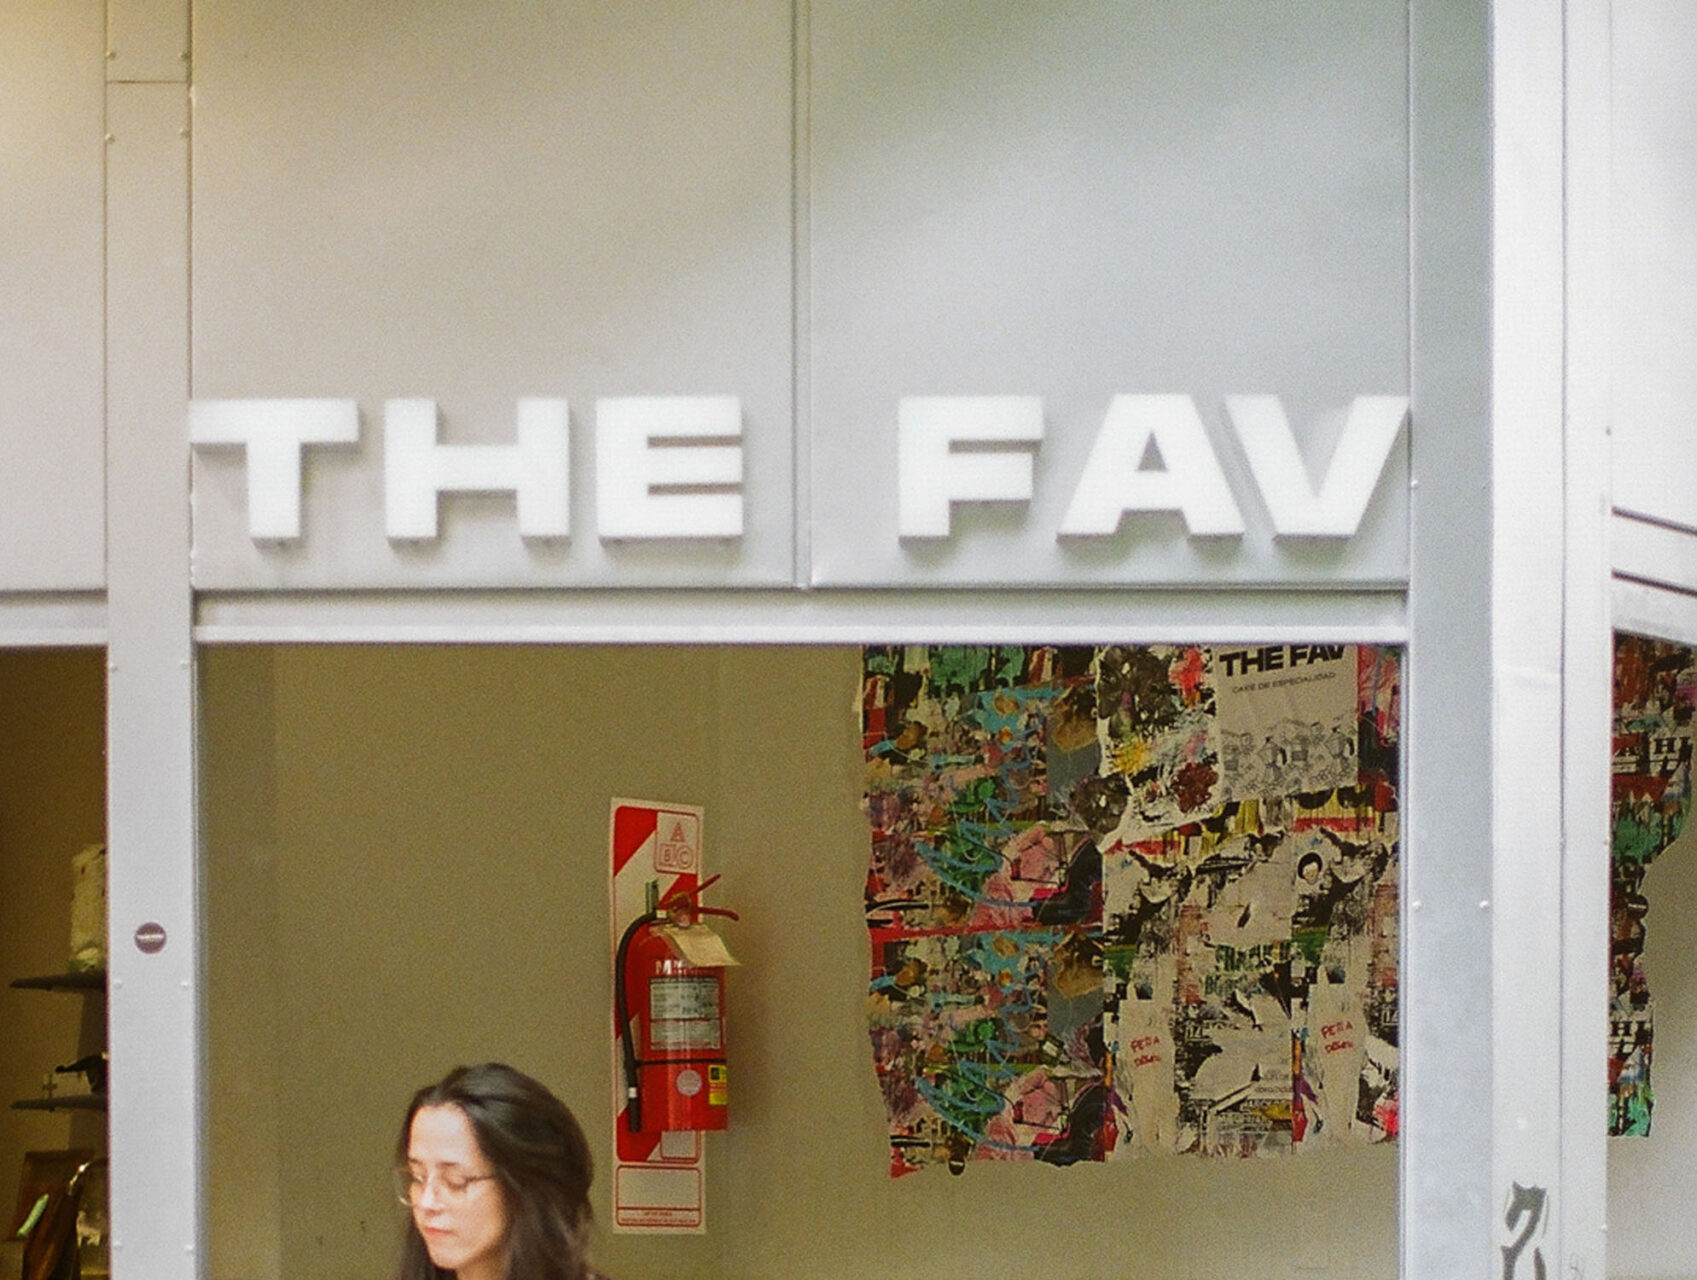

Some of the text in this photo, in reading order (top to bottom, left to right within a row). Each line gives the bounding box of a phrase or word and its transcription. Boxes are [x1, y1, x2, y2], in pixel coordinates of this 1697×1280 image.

[190, 394, 1409, 542] THE FAV
[1219, 645, 1284, 677] THE
